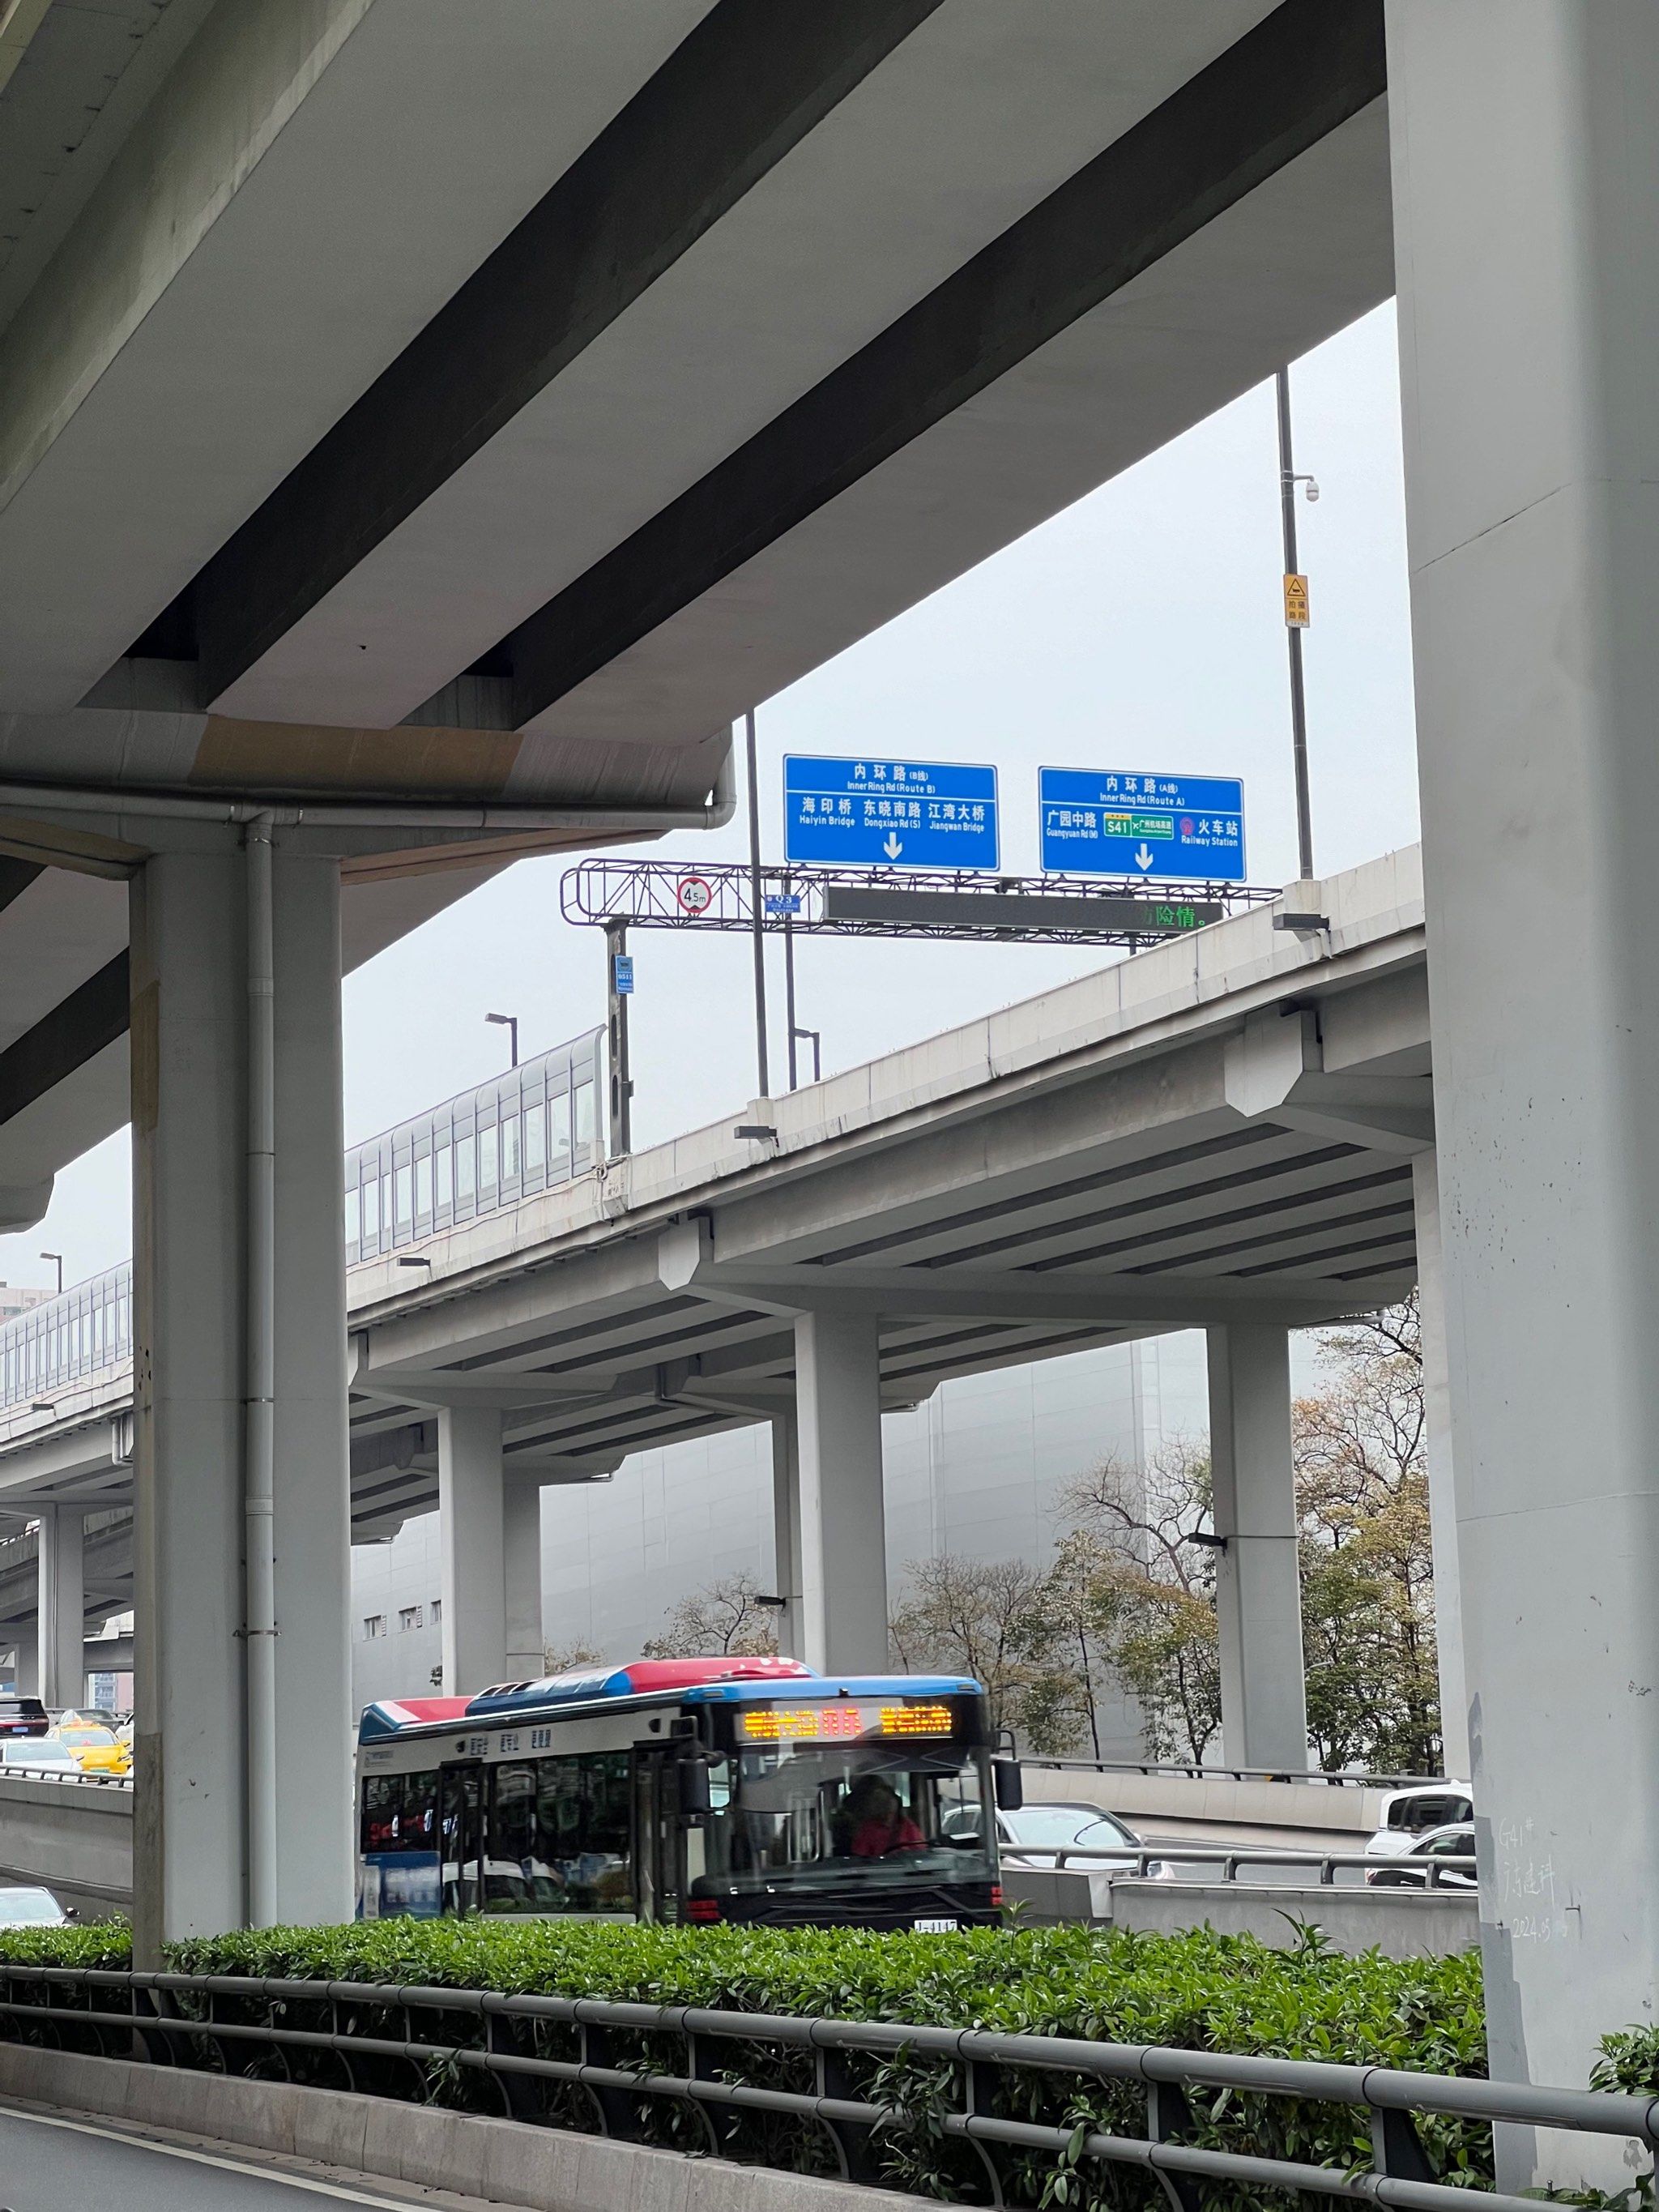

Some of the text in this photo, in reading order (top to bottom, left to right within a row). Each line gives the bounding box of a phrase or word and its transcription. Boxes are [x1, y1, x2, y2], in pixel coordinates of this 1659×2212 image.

[847, 781, 867, 790] Inner
[868, 782, 885, 793] Ring
[1100, 793, 1119, 802] Inner
[1120, 794, 1136, 805] Ring
[802, 796, 985, 821] 海印桥 东晓南路 江湾大桥
[800, 814, 855, 827] Haiyin Bridge
[864, 818, 898, 830] Dongxiao
[1047, 809, 1097, 829] 广园中路
[929, 821, 985, 834] Jiangwan Bridge
[1107, 821, 1127, 834] S41
[1198, 819, 1239, 837] 火车站
[1181, 835, 1239, 847] Railway Station
